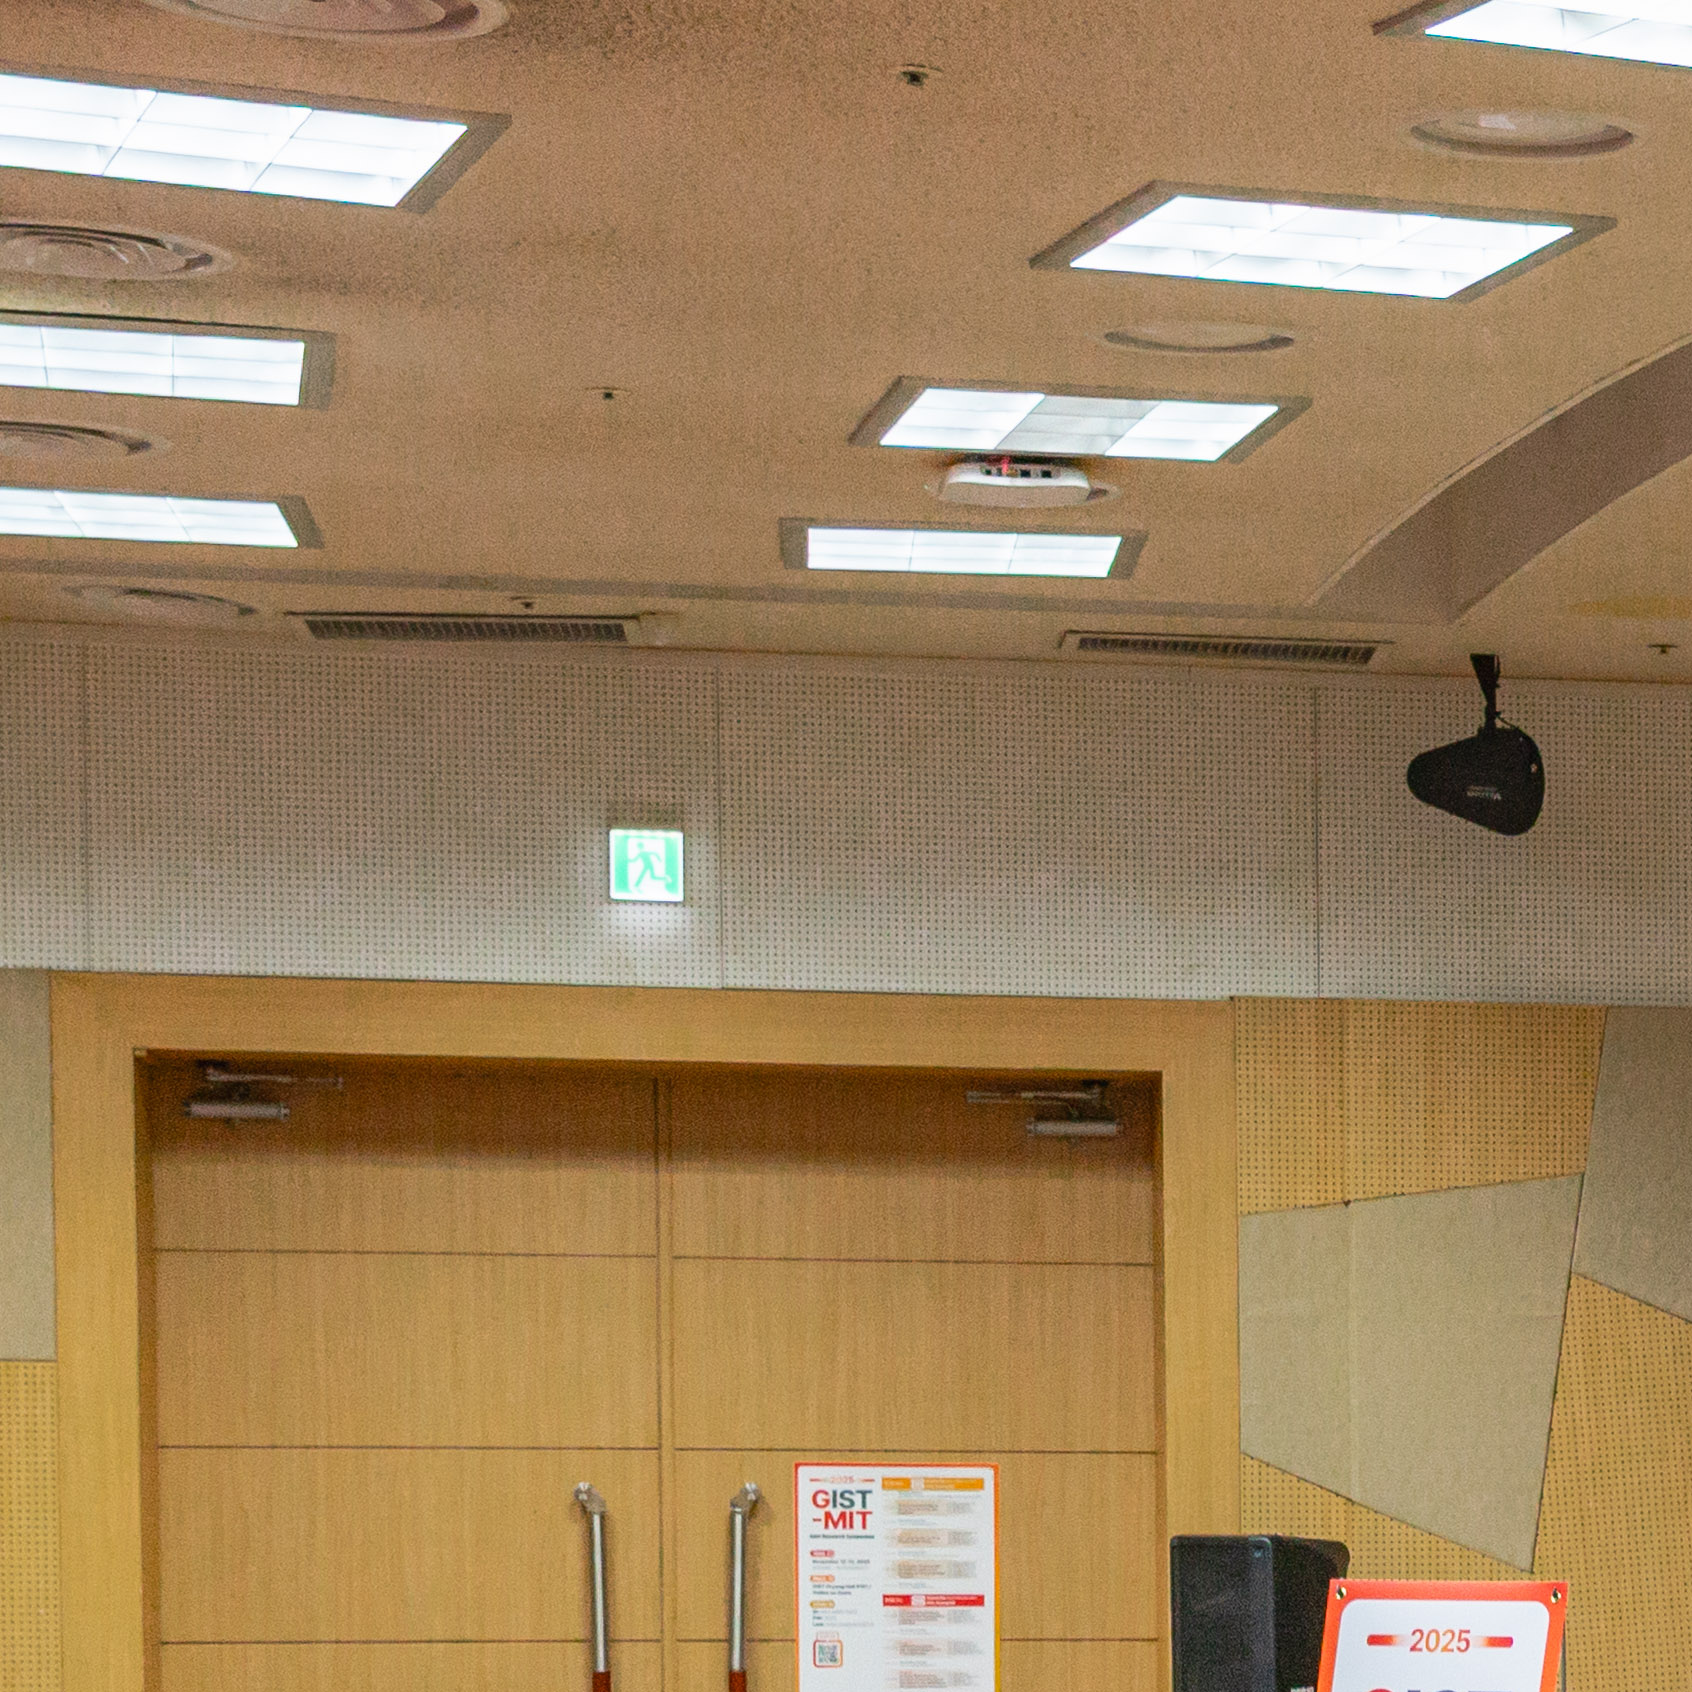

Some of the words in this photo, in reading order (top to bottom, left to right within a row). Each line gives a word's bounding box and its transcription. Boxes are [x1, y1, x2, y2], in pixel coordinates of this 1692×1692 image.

[812, 1489, 872, 1509] GIST
[813, 1510, 872, 1529] -MIT
[1410, 1629, 1471, 1652] 2025
